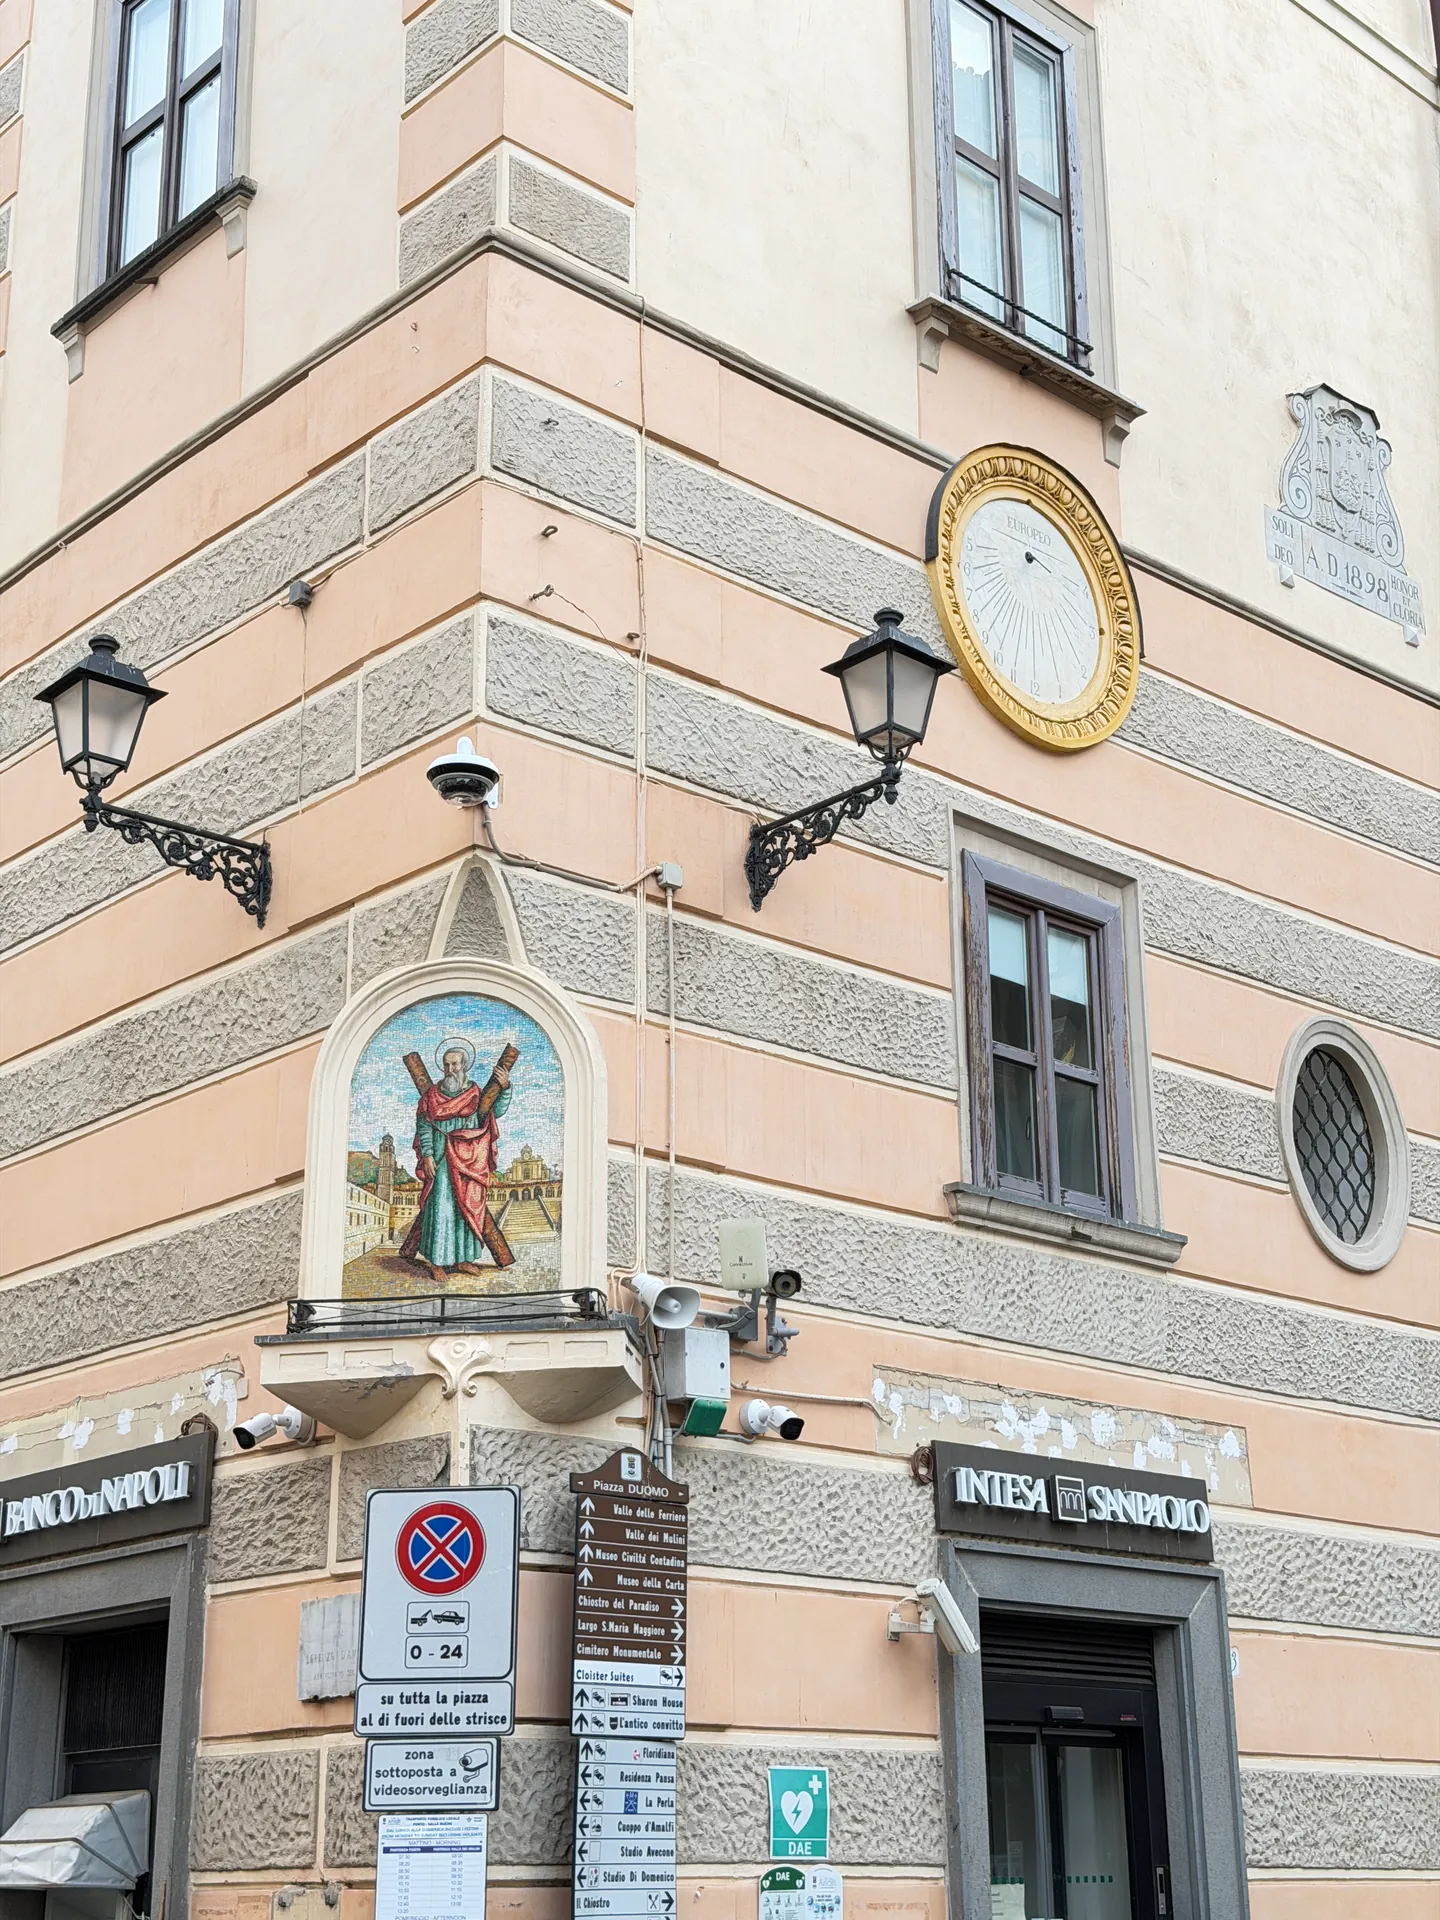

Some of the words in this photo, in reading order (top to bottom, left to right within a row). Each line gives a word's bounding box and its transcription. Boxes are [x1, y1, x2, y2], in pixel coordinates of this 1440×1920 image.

[1006, 515, 1051, 547] EUROPEO
[1271, 515, 1295, 539] SOLI
[966, 537, 973, 551] 5
[1274, 543, 1294, 566] DEO
[963, 561, 971, 577] 6
[1344, 563, 1389, 604] 1898
[1390, 574, 1420, 601] HONOR
[966, 587, 973, 601] 7
[1402, 596, 1411, 607] ET
[972, 608, 980, 624] 8
[982, 630, 989, 645] 9
[1088, 625, 1096, 640] 3
[993, 650, 1004, 667] 10
[1080, 664, 1088, 680] 2
[1030, 680, 1040, 697] 12
[593, 1480, 624, 1493] Piazza
[628, 1484, 669, 1498] DUOMO
[3, 1486, 85, 1537] BANCO
[99, 1461, 194, 1516] NAPOLI
[955, 1466, 1050, 1514] INTESA
[1087, 1485, 1211, 1534] SANPAOLO
[613, 1503, 633, 1517] Valle
[636, 1505, 655, 1519] delle
[658, 1508, 686, 1522] Ferriere
[625, 1528, 645, 1541] Valle
[648, 1530, 659, 1543] dei
[663, 1532, 686, 1545] Mulini
[595, 1549, 618, 1562] Museo
[650, 1554, 685, 1568] Contadina
[617, 1574, 639, 1587] Museo
[642, 1576, 662, 1589] della
[665, 1578, 685, 1591] Carta
[578, 1595, 610, 1608] Chiostro
[613, 1598, 625, 1610] del
[629, 1599, 660, 1612] Paradiso
[577, 1618, 598, 1632] Largo
[633, 1622, 665, 1638] Maggiore
[410, 1644, 422, 1660] 0
[440, 1644, 463, 1660] 24
[576, 1643, 609, 1657] Cimitero
[613, 1645, 662, 1660] Monumentale
[576, 1670, 608, 1682] Cloister
[610, 1671, 634, 1683] Suites
[380, 1694, 394, 1705] su
[399, 1691, 430, 1705] tutta
[436, 1691, 447, 1704] la
[453, 1691, 489, 1706] piazza
[632, 1695, 658, 1707] Sharon
[662, 1697, 683, 1709] House
[360, 1713, 373, 1726] al
[378, 1713, 390, 1726] di
[395, 1712, 424, 1726] fuori
[429, 1712, 461, 1726] delle
[465, 1711, 507, 1726] strisce
[619, 1716, 649, 1730] L'antico
[652, 1719, 683, 1731] convitto
[404, 1750, 434, 1760] zona
[642, 1747, 675, 1760] Floridiana
[375, 1766, 443, 1779] sottoposta
[450, 1768, 457, 1777] a
[619, 1770, 651, 1783] Residenza
[655, 1772, 675, 1784] Pansa
[374, 1783, 488, 1797] videosorveglianza
[645, 1796, 654, 1808] La
[656, 1796, 675, 1808] Perla
[617, 1821, 642, 1834] Cuoppo
[645, 1820, 675, 1833] d'Amalfi
[620, 1846, 643, 1858] Studio
[646, 1846, 675, 1858] Avecone
[788, 1841, 812, 1855] DAE
[603, 1871, 626, 1883] Studio
[629, 1871, 638, 1882] Di
[641, 1870, 675, 1882] Domenico
[775, 1871, 790, 1881] DAE
[583, 1896, 610, 1908] Chiostro
